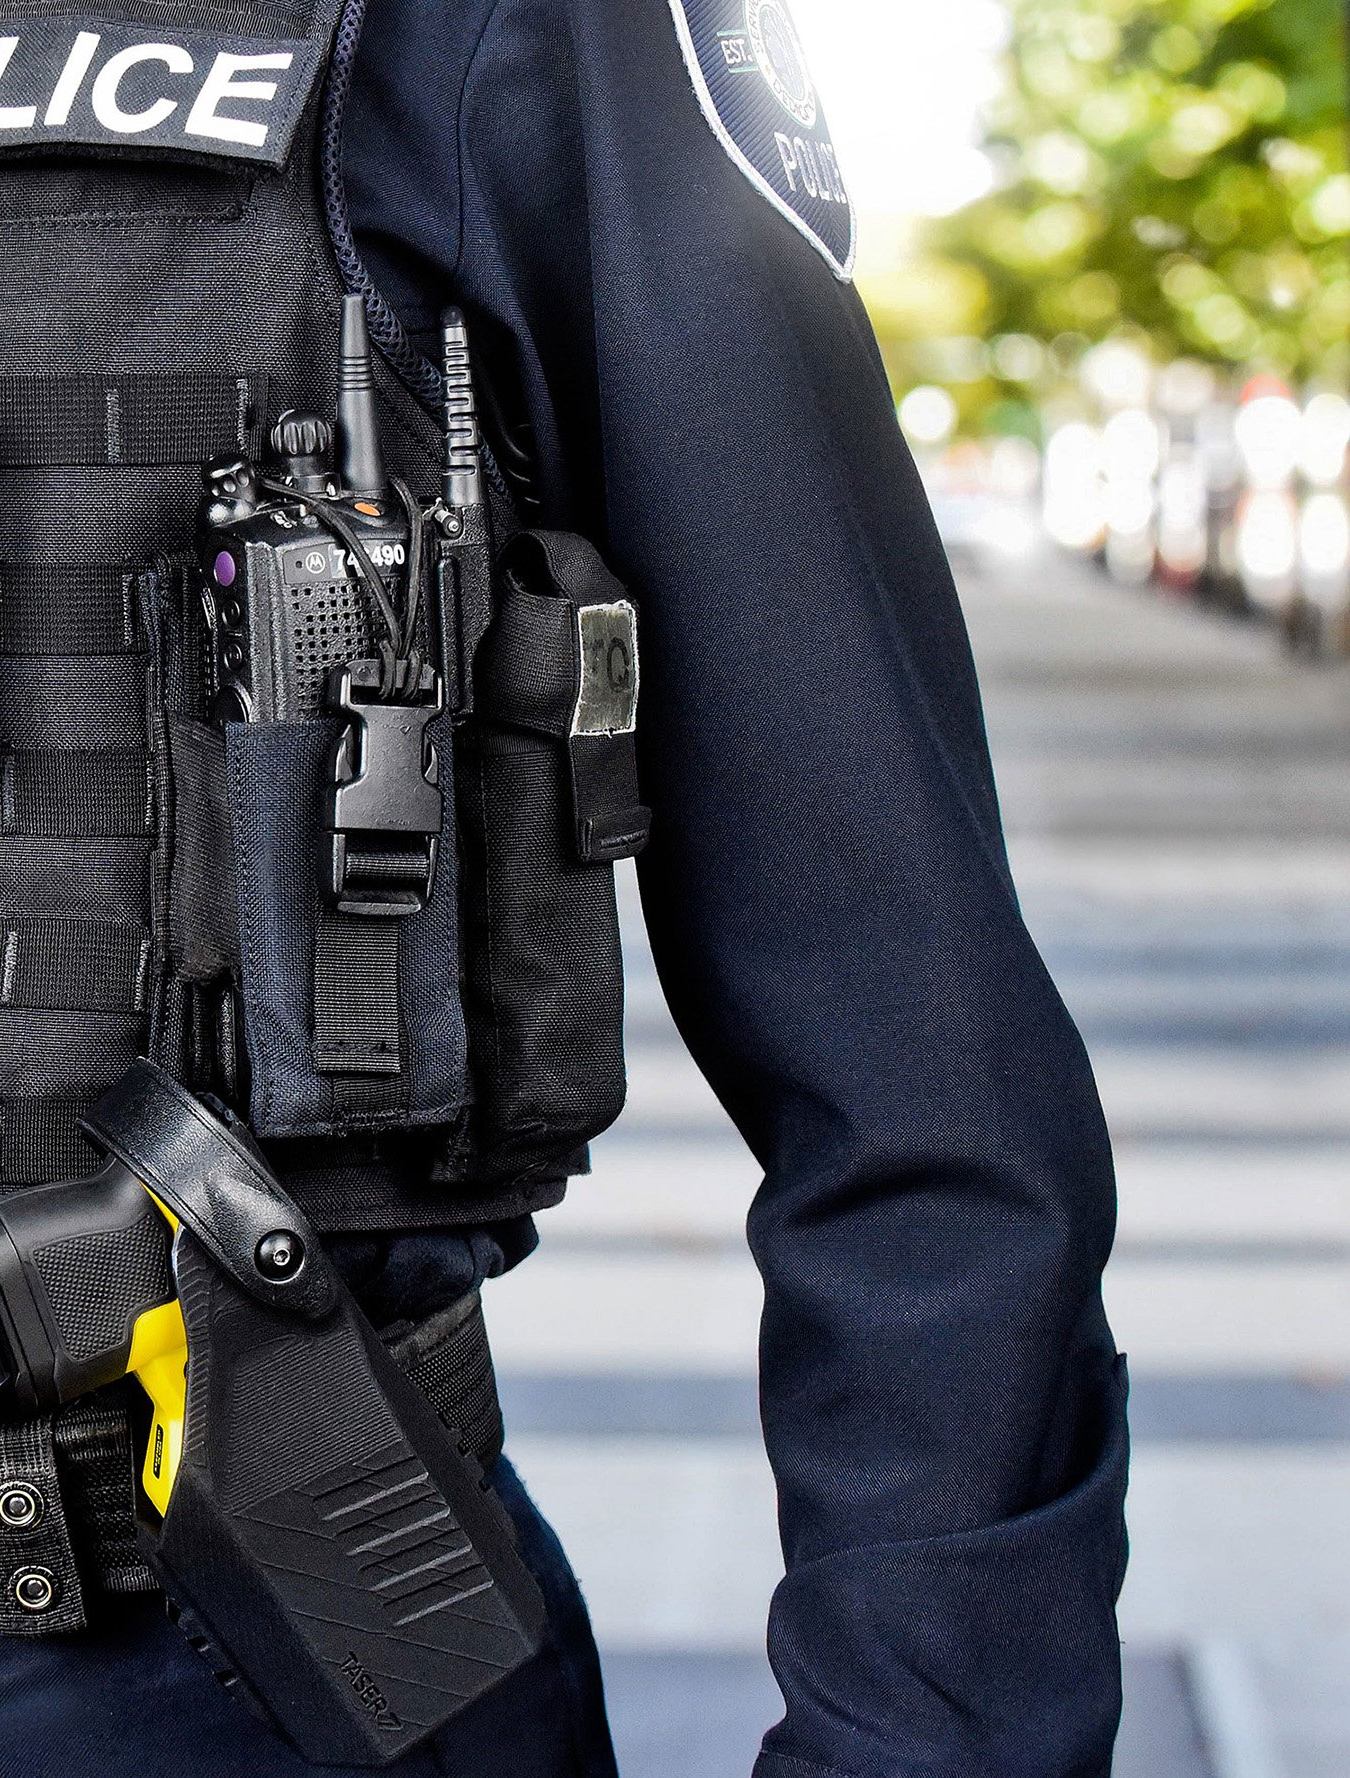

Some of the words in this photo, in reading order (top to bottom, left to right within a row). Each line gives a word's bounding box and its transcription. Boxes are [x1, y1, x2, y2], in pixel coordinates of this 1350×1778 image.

[721, 39, 753, 64] EST.
[332, 543, 405, 572] 74490
[340, 1650, 387, 1718] TASER
[376, 1711, 404, 1731] 7
